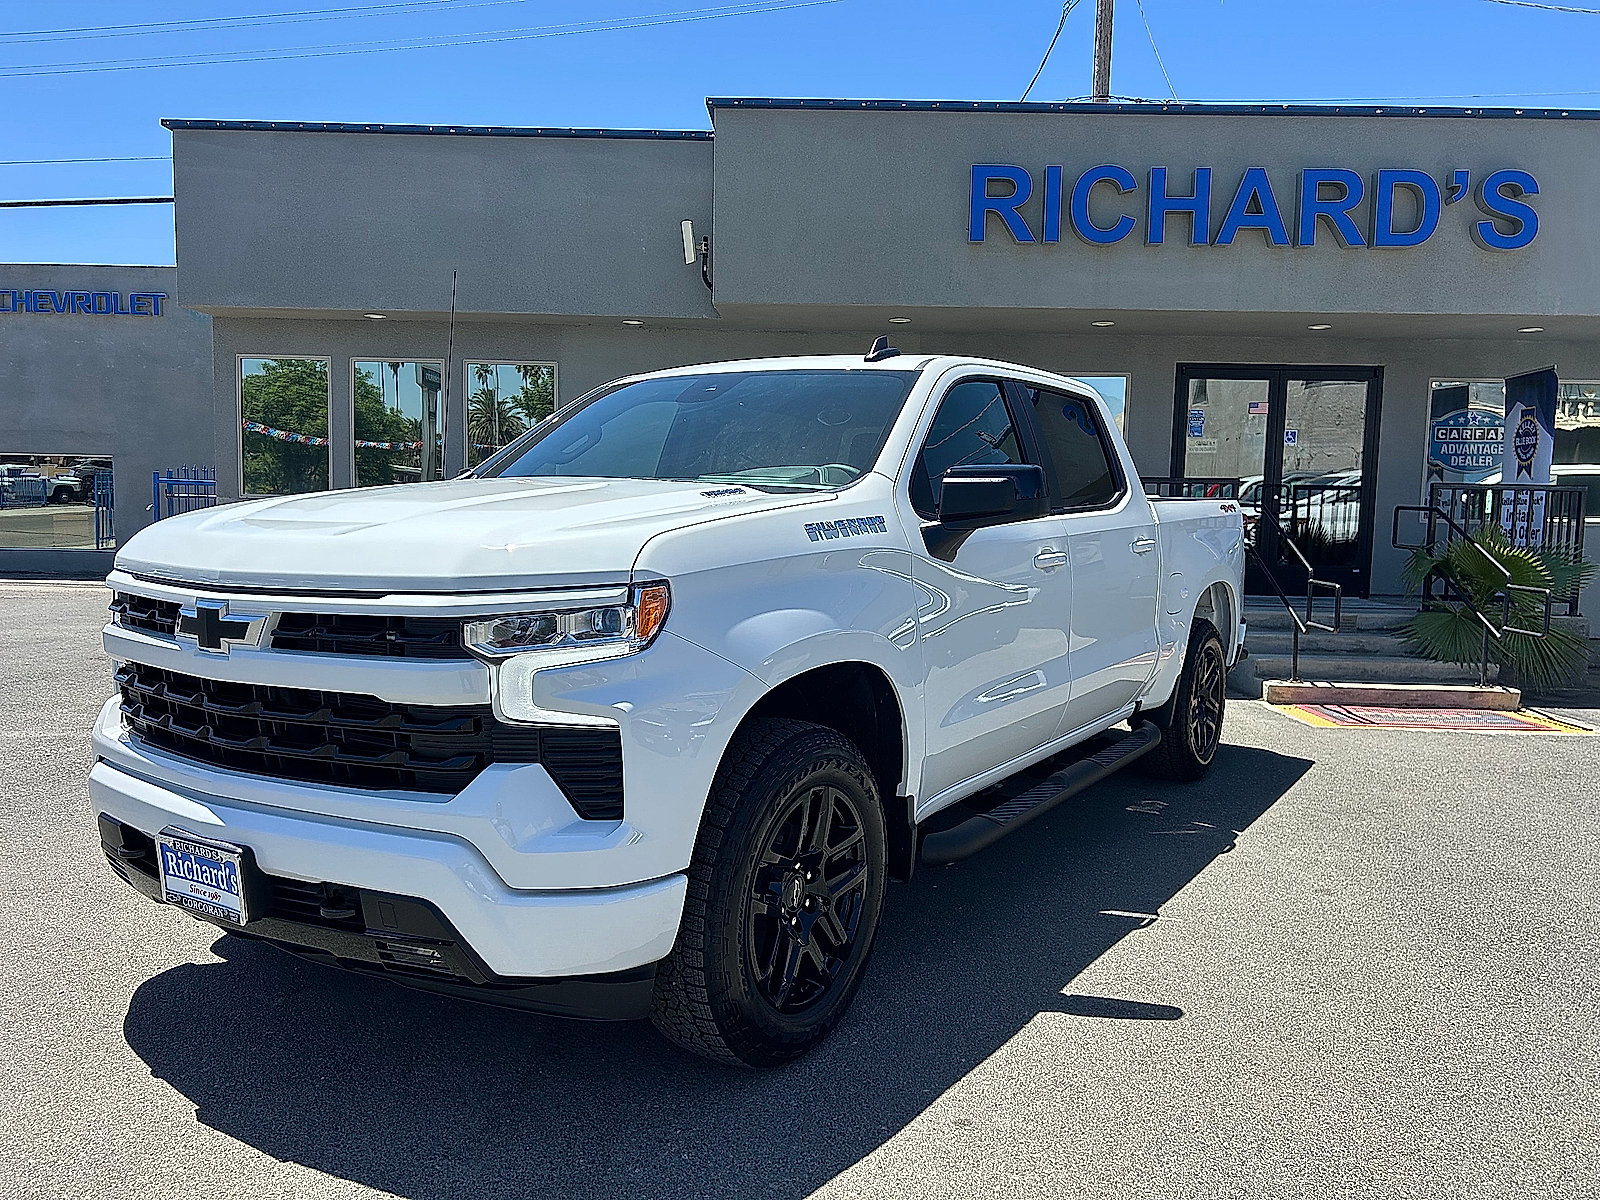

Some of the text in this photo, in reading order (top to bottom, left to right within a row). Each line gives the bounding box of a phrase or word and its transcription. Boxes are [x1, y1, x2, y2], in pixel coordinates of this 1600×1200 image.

[967, 162, 1541, 250] RICHARD'S
[1440, 443, 1504, 455] ADVANTAGE
[1450, 455, 1493, 467] DEALER
[165, 851, 238, 894] Richard's
[189, 883, 207, 897] Since
[182, 897, 224, 918] CORCORAN
